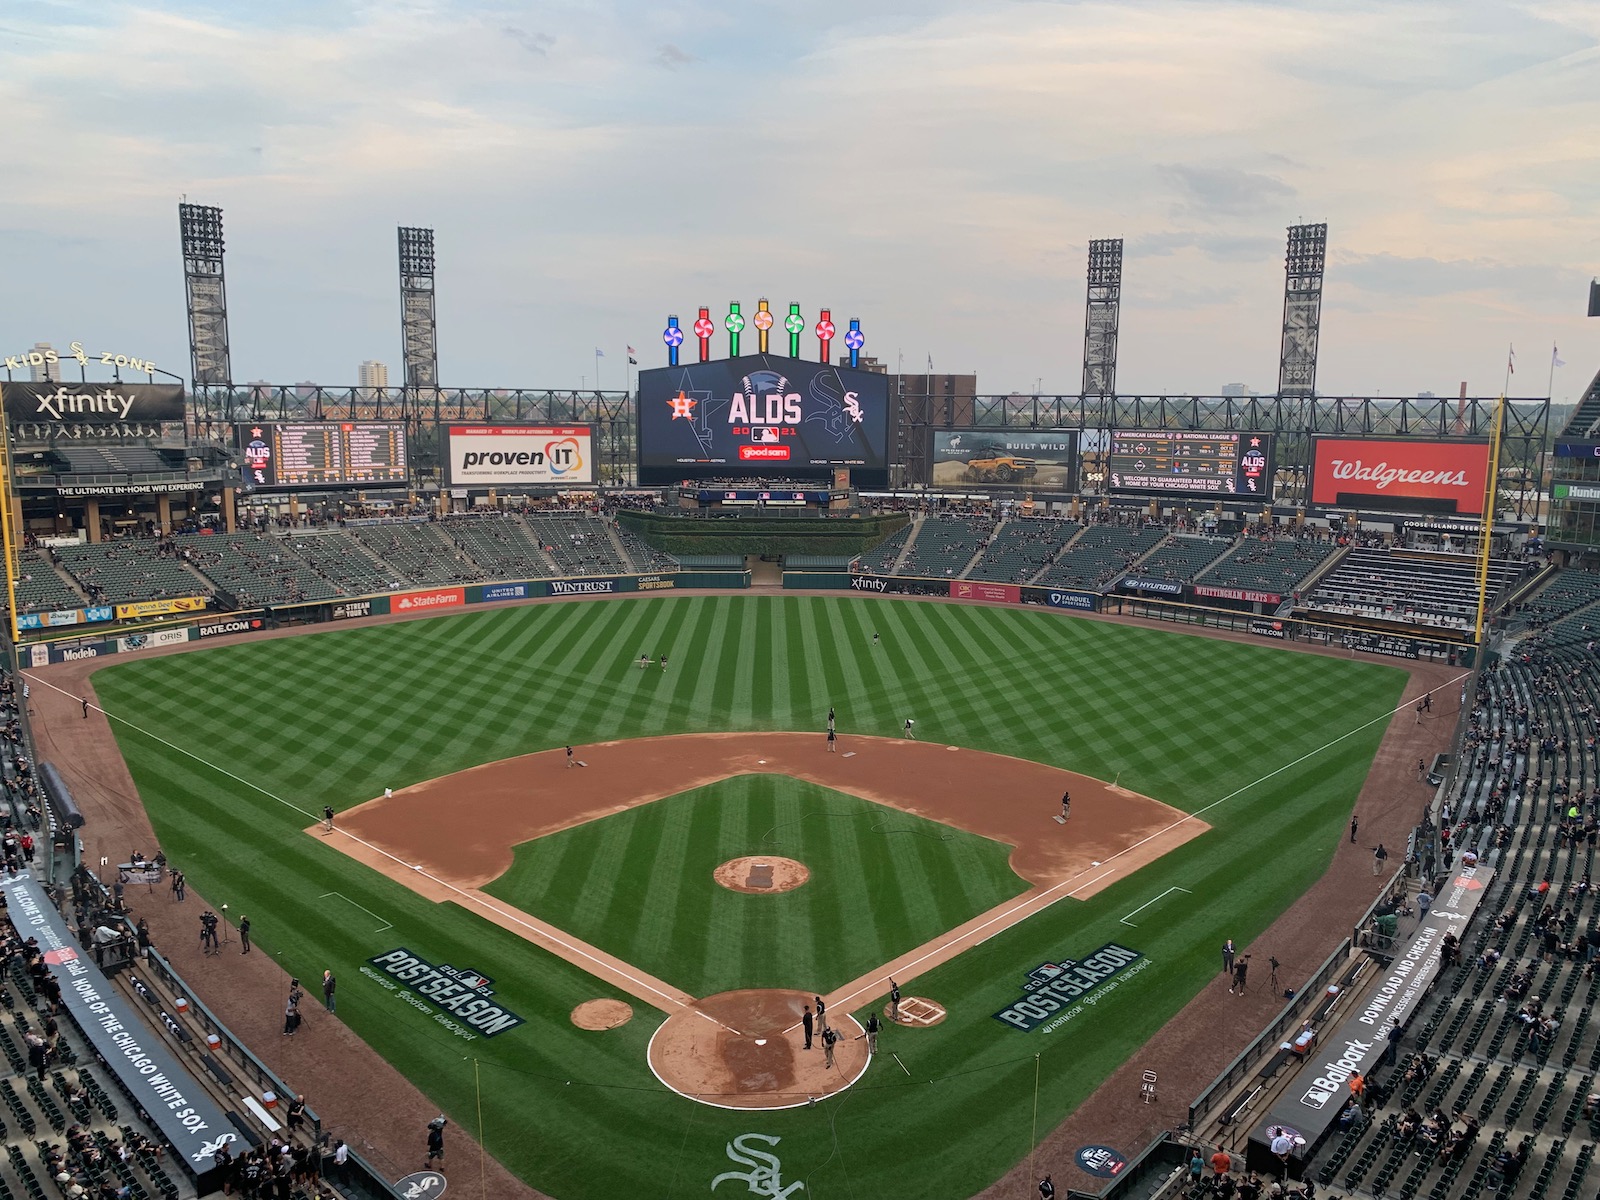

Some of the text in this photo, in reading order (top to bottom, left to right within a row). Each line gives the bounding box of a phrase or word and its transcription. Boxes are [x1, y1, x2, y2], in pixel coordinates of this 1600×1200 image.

[5, 350, 58, 370] KIDS
[100, 352, 156, 374] ZONE
[1286, 371, 1309, 379] SOX
[36, 387, 136, 420] xfinity
[728, 393, 802, 424] ALDS
[246, 447, 270, 458] ALDS
[463, 449, 572, 469] proven IT
[1242, 457, 1265, 467] ALDS
[1331, 460, 1469, 489] Walgreens
[75, 486, 114, 494] ULTIMATE
[115, 485, 150, 494] IN-HOME
[168, 482, 204, 491] EXPERIENCE
[552, 582, 613, 592] WINTRUST
[638, 581, 674, 589] SPORTSBOOK
[851, 577, 887, 592] xfinity
[1139, 582, 1176, 591] HYUNDAI
[1196, 587, 1243, 600] WHITTINGHAM
[1245, 592, 1268, 602] MEATS
[346, 602, 370, 610] STREAM
[1062, 595, 1091, 603] FANDUEL
[160, 632, 182, 641] ORIS
[201, 622, 249, 636] RATE.COM
[1252, 627, 1283, 637] RATE.COM
[63, 648, 96, 661] Modelo
[11, 885, 40, 916] WELCOME
[30, 915, 45, 925] TO
[63, 959, 88, 977] Field
[1024, 960, 1077, 991] 20 21
[1117, 958, 1153, 982] loanDepot
[1359, 927, 1438, 1025] DOWNLOAD AND CHECK-IN
[1411, 959, 1435, 991] EXPERIENCES
[72, 978, 96, 1003] HOME
[440, 965, 495, 996] 20 21
[999, 944, 1138, 1029] POSTSEASON
[373, 950, 518, 1035] POSTSEASON
[89, 1002, 106, 1014] OF
[1387, 986, 1415, 1022] CONCESSIONS
[98, 1013, 124, 1034] THE
[433, 1014, 478, 1041] loanDepot
[1373, 1025, 1390, 1042] MAPS
[112, 1032, 157, 1074] CHICAGO
[1313, 1039, 1370, 1092] Ballpark
[148, 1073, 188, 1110] WHITE
[176, 1108, 208, 1135] SOX
[1086, 1149, 1112, 1170] ALDS
